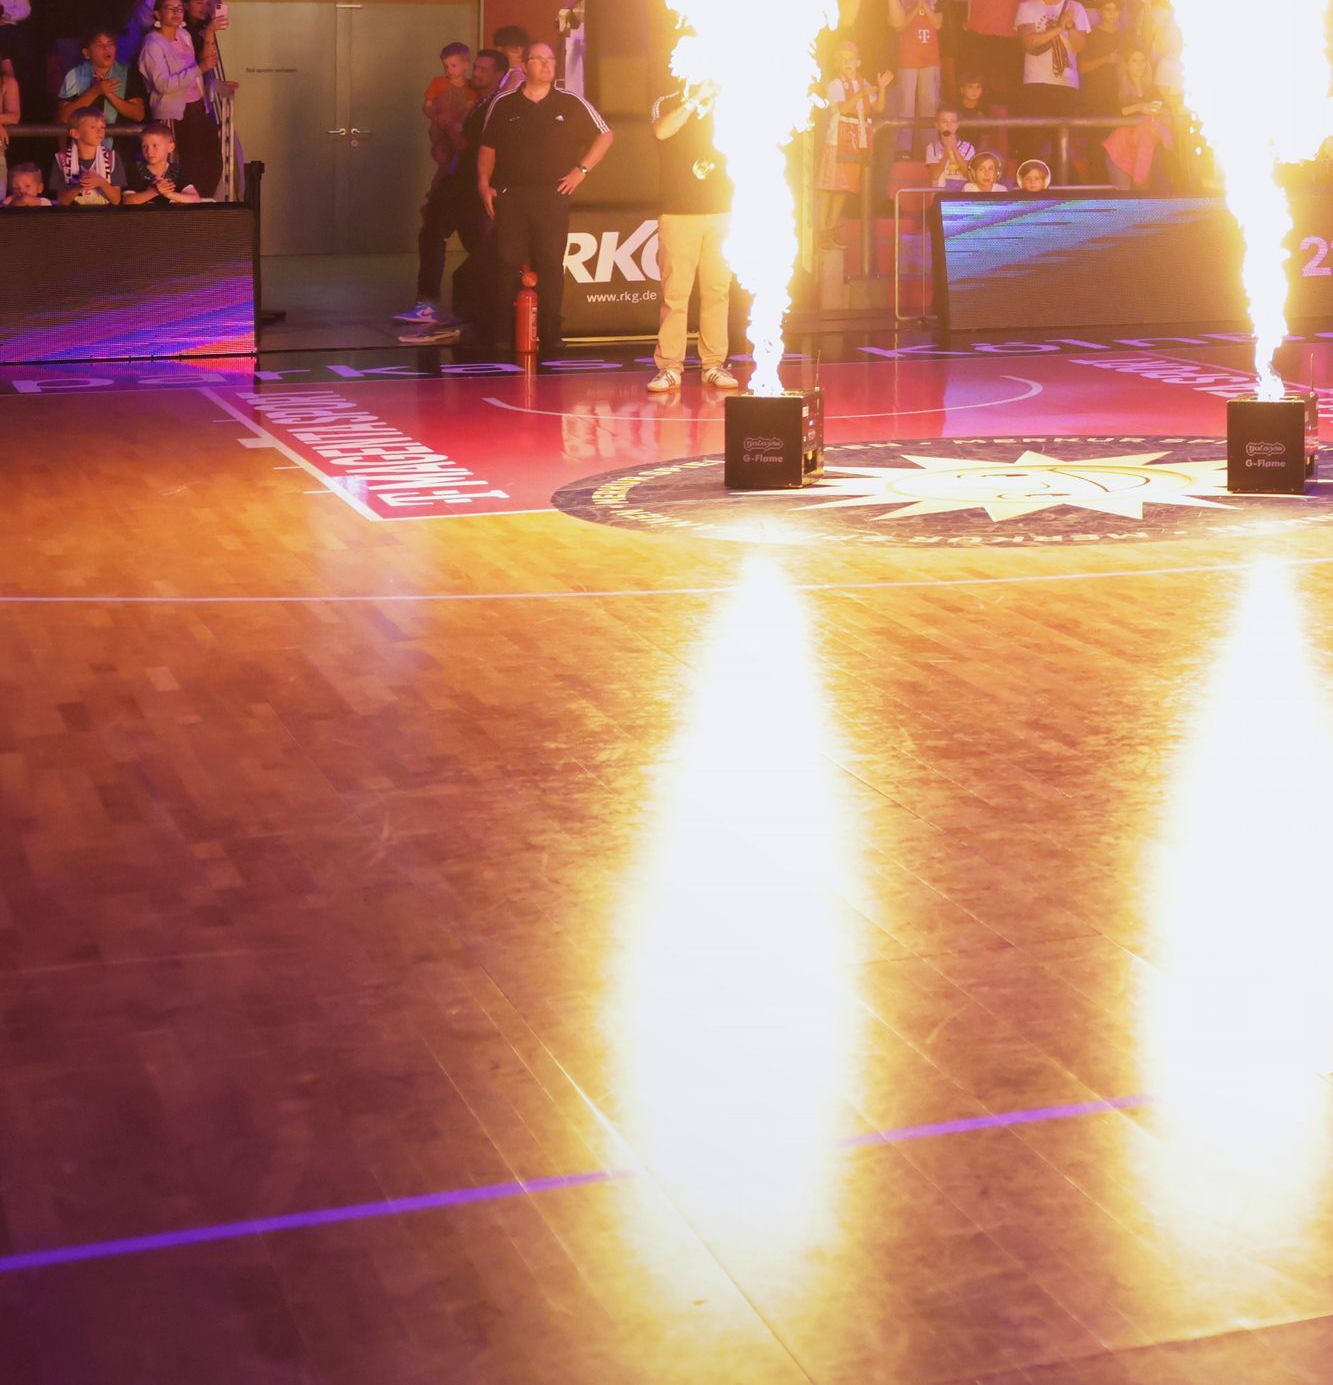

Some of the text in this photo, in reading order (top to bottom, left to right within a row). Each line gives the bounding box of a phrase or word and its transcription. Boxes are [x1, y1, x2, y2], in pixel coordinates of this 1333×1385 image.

[586, 290, 657, 304] www.rkg.de
[743, 454, 783, 463] G-Flame
[1245, 459, 1286, 468] G-Flame
